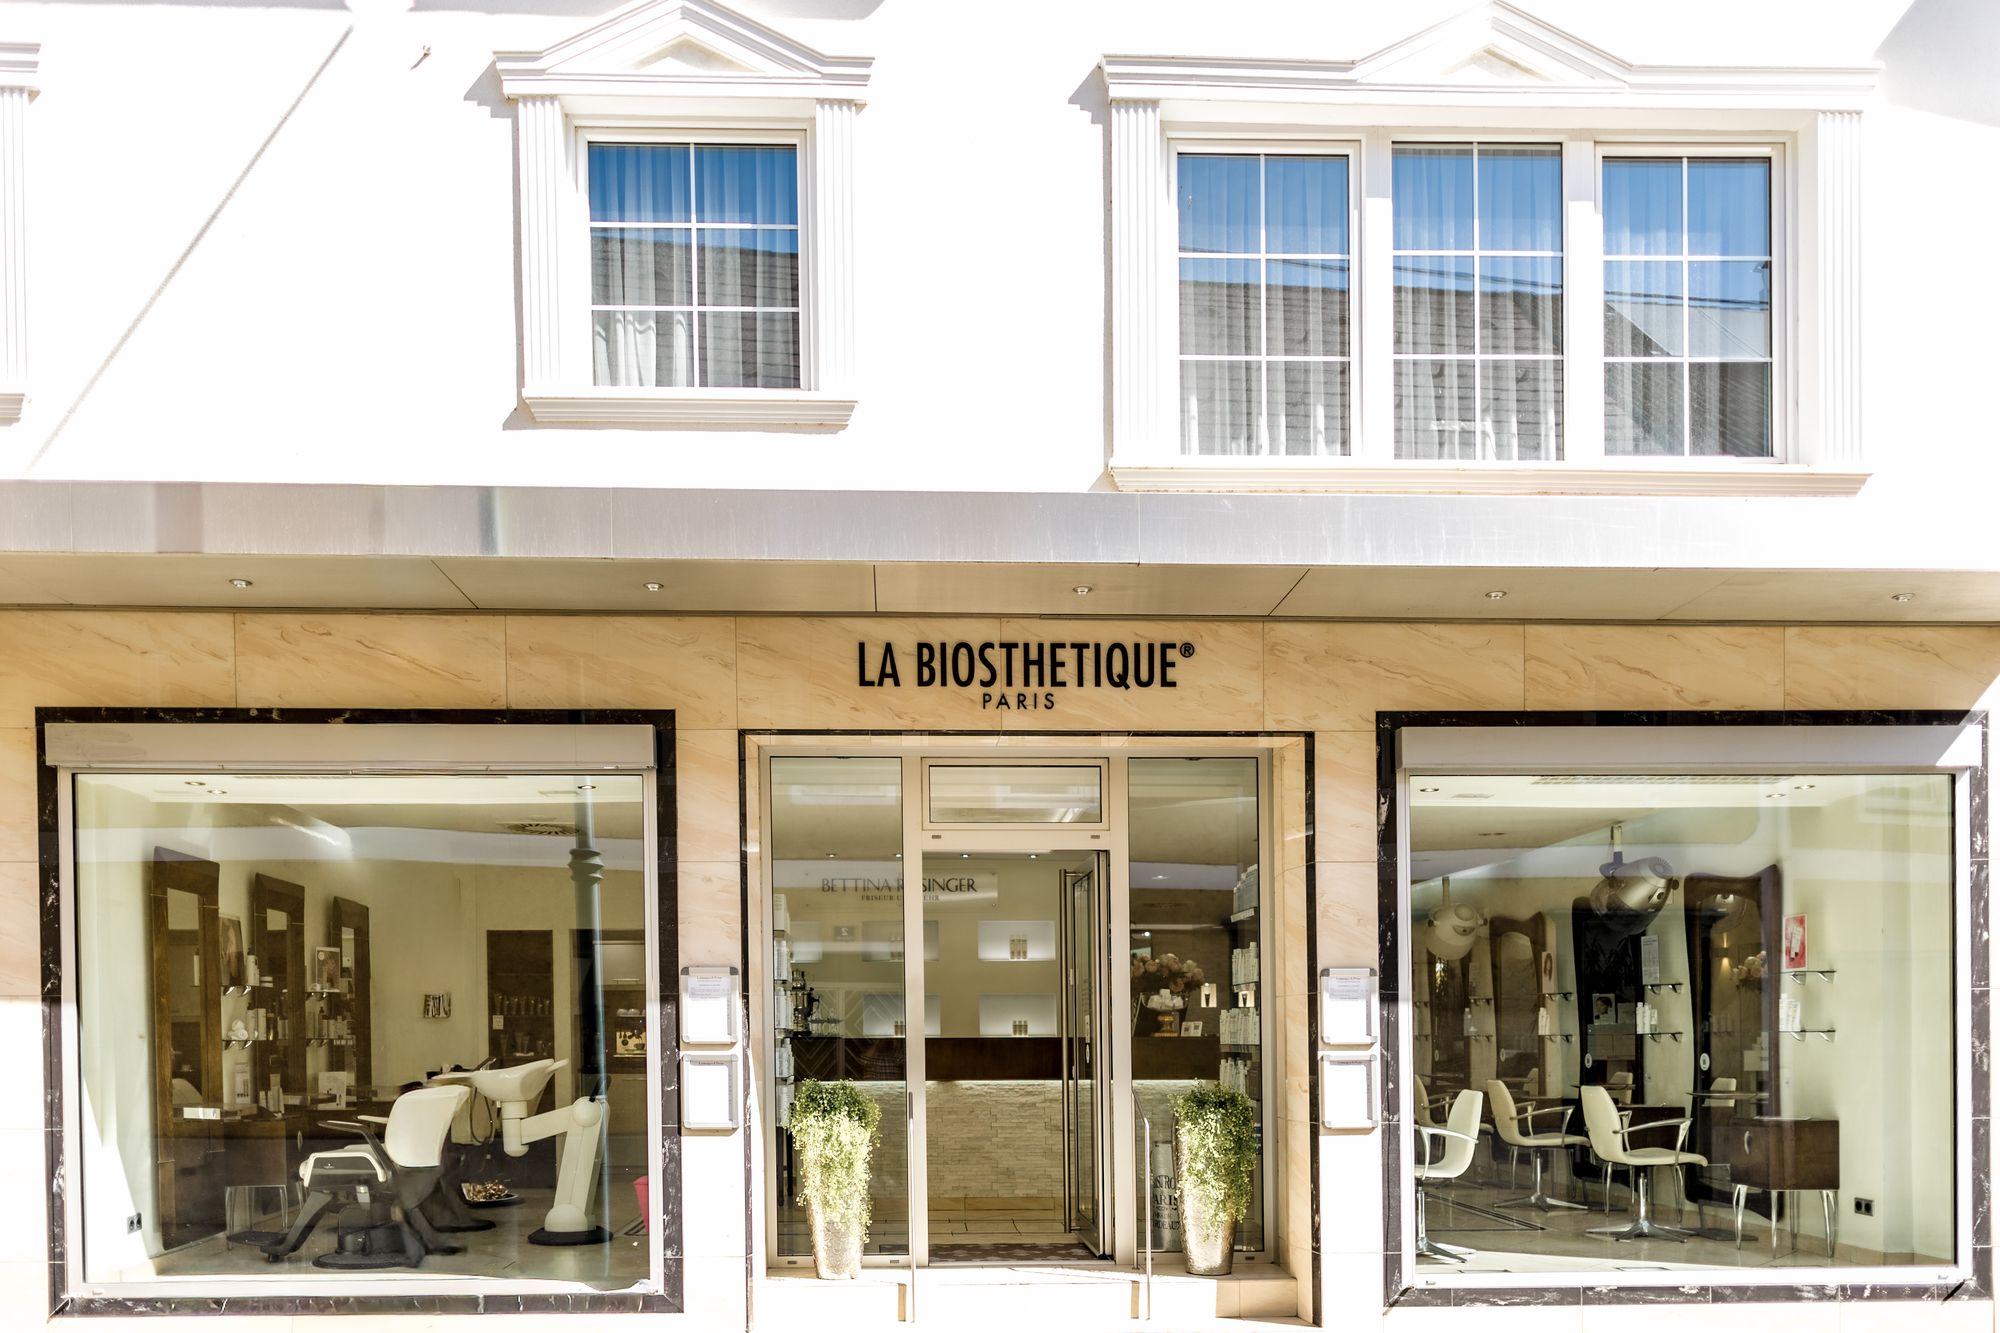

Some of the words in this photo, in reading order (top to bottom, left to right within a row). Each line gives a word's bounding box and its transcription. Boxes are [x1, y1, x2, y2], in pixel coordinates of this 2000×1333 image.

[858, 642, 901, 687] LA
[982, 693, 1055, 710] PARIS
[821, 878, 892, 893] BETTINA
[896, 877, 978, 893] RSINGER
